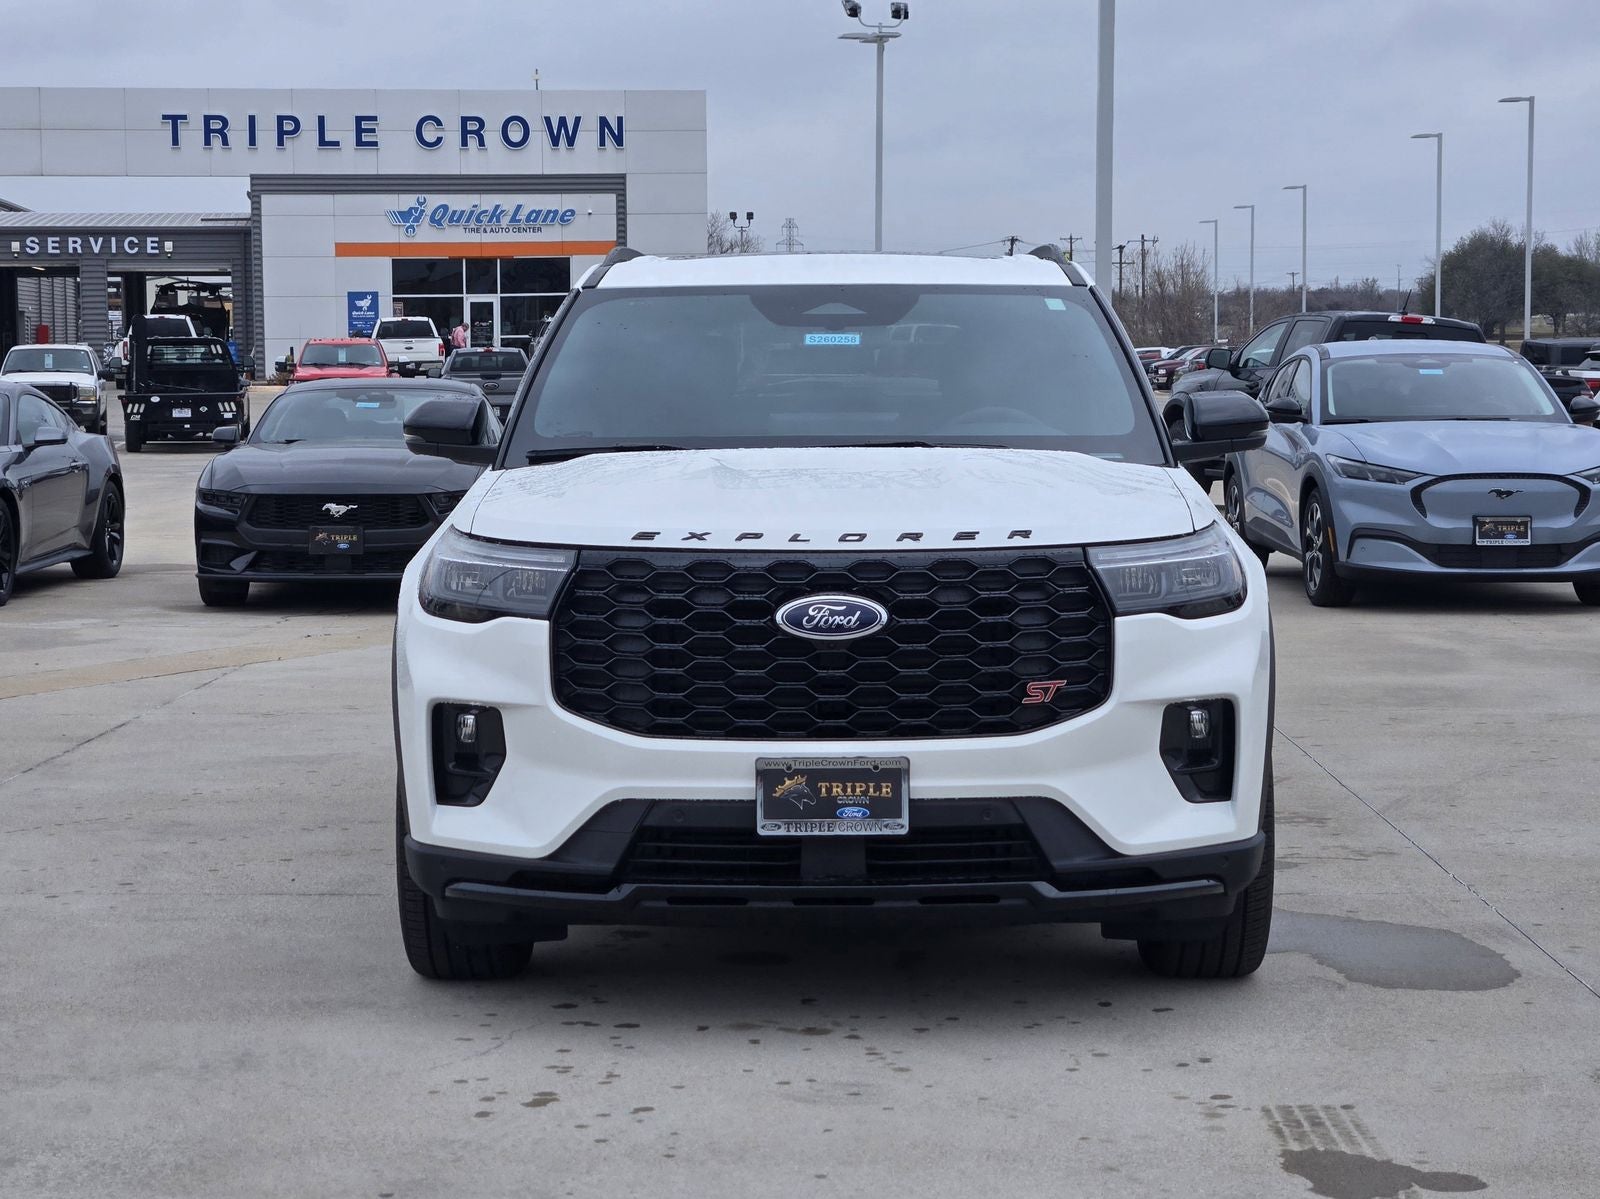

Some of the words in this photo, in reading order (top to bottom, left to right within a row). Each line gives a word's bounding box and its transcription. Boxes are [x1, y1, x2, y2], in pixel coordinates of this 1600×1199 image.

[161, 114, 380, 148] TRIPLE
[415, 115, 625, 149] CROWN
[429, 203, 506, 229] Quick
[508, 203, 576, 226] Lane
[25, 236, 160, 254] SERVICE
[808, 335, 857, 344] S260258
[631, 529, 1033, 544] EXPLORER
[802, 604, 861, 629] Ford
[1022, 680, 1067, 704] ST
[764, 759, 901, 769] www.TripleCrownFord.com
[817, 782, 892, 798] TRIPLE
[836, 796, 870, 804] CROWN
[842, 807, 863, 818] Ford
[784, 821, 835, 832] TRIPLE
[838, 821, 883, 832] CROWN
